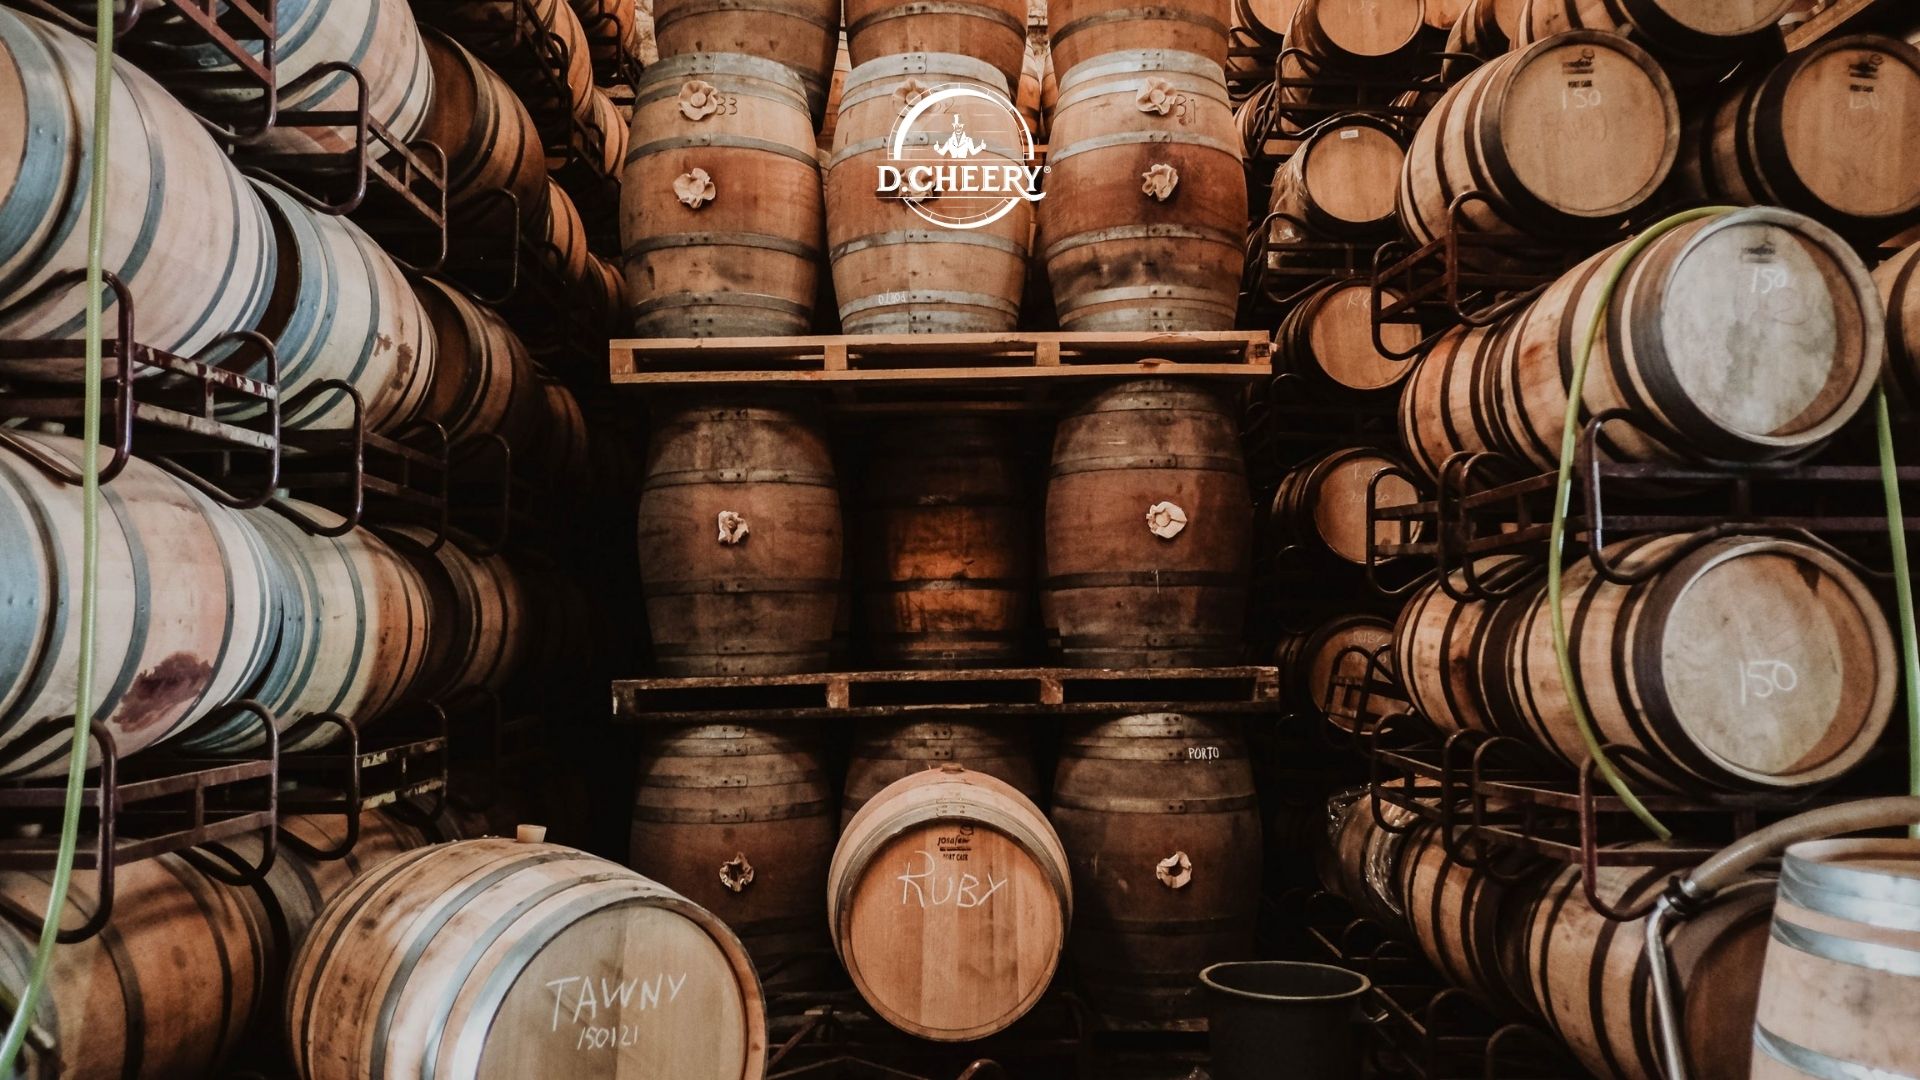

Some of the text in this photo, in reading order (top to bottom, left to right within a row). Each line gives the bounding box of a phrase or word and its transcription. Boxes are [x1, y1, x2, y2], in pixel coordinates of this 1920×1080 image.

[1561, 88, 1602, 110] 150
[1750, 266, 1788, 294] 150
[1738, 659, 1798, 706] 150
[1188, 746, 1220, 760] PORTO
[896, 850, 1008, 908] RUBY
[545, 970, 687, 1032] TAWNY
[576, 1024, 639, 1050] 150121
